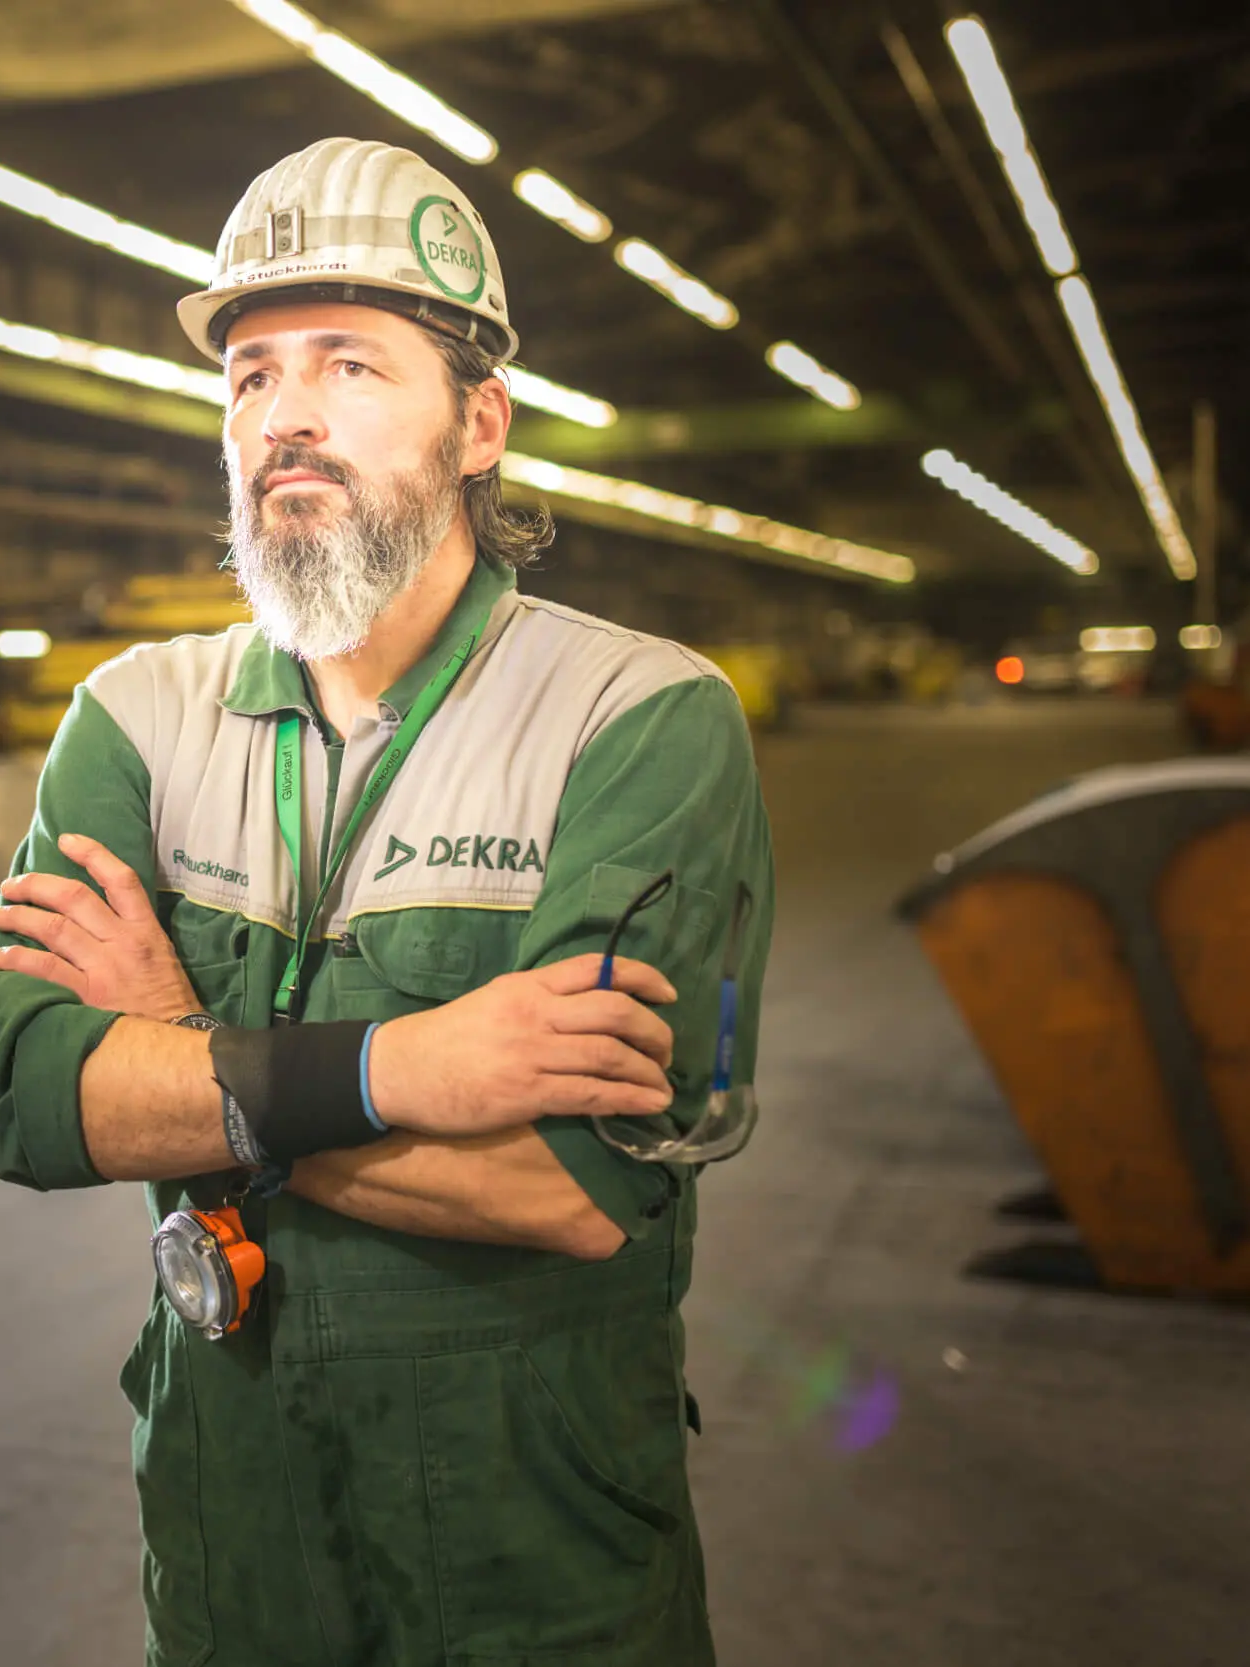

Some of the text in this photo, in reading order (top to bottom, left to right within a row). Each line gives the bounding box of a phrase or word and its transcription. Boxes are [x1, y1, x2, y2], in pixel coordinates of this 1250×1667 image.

[246, 262, 348, 283] Stuckhardt
[427, 240, 478, 273] DEKRA
[426, 834, 544, 873] DEKRA
